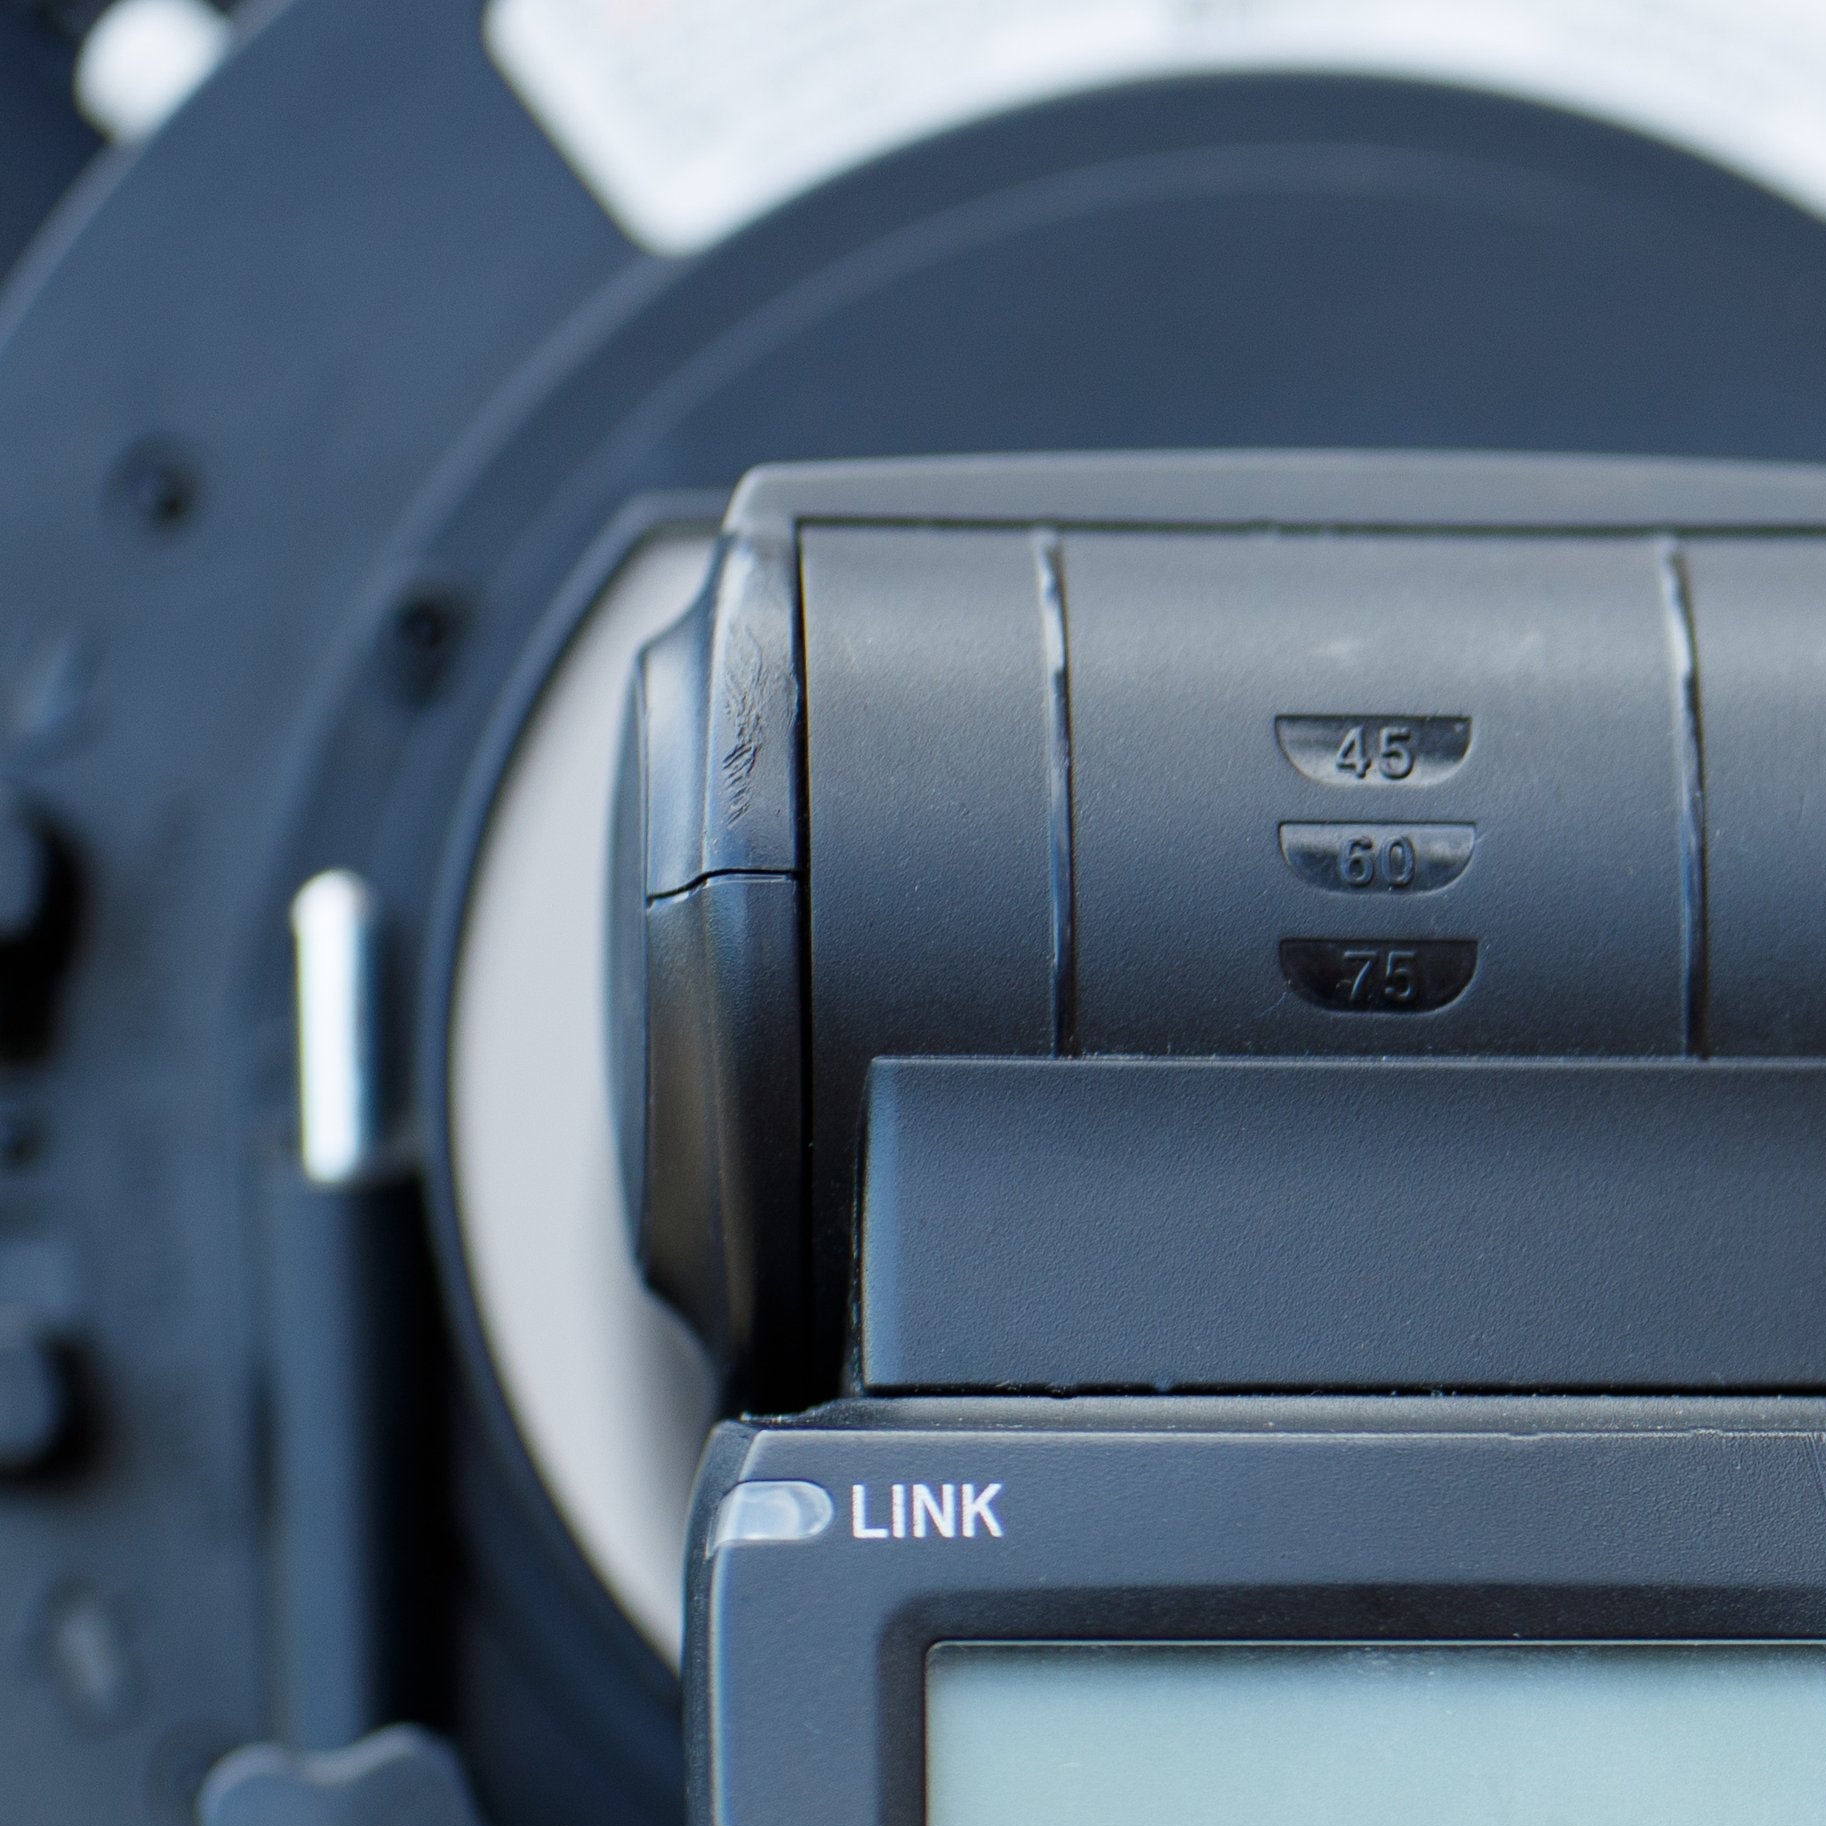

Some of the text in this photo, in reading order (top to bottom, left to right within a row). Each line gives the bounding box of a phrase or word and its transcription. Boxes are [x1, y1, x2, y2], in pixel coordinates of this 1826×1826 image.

[1335, 725, 1417, 780] 45
[1338, 834, 1417, 888] 60
[1342, 949, 1418, 1003] 75
[851, 1482, 1005, 1539] LINK
